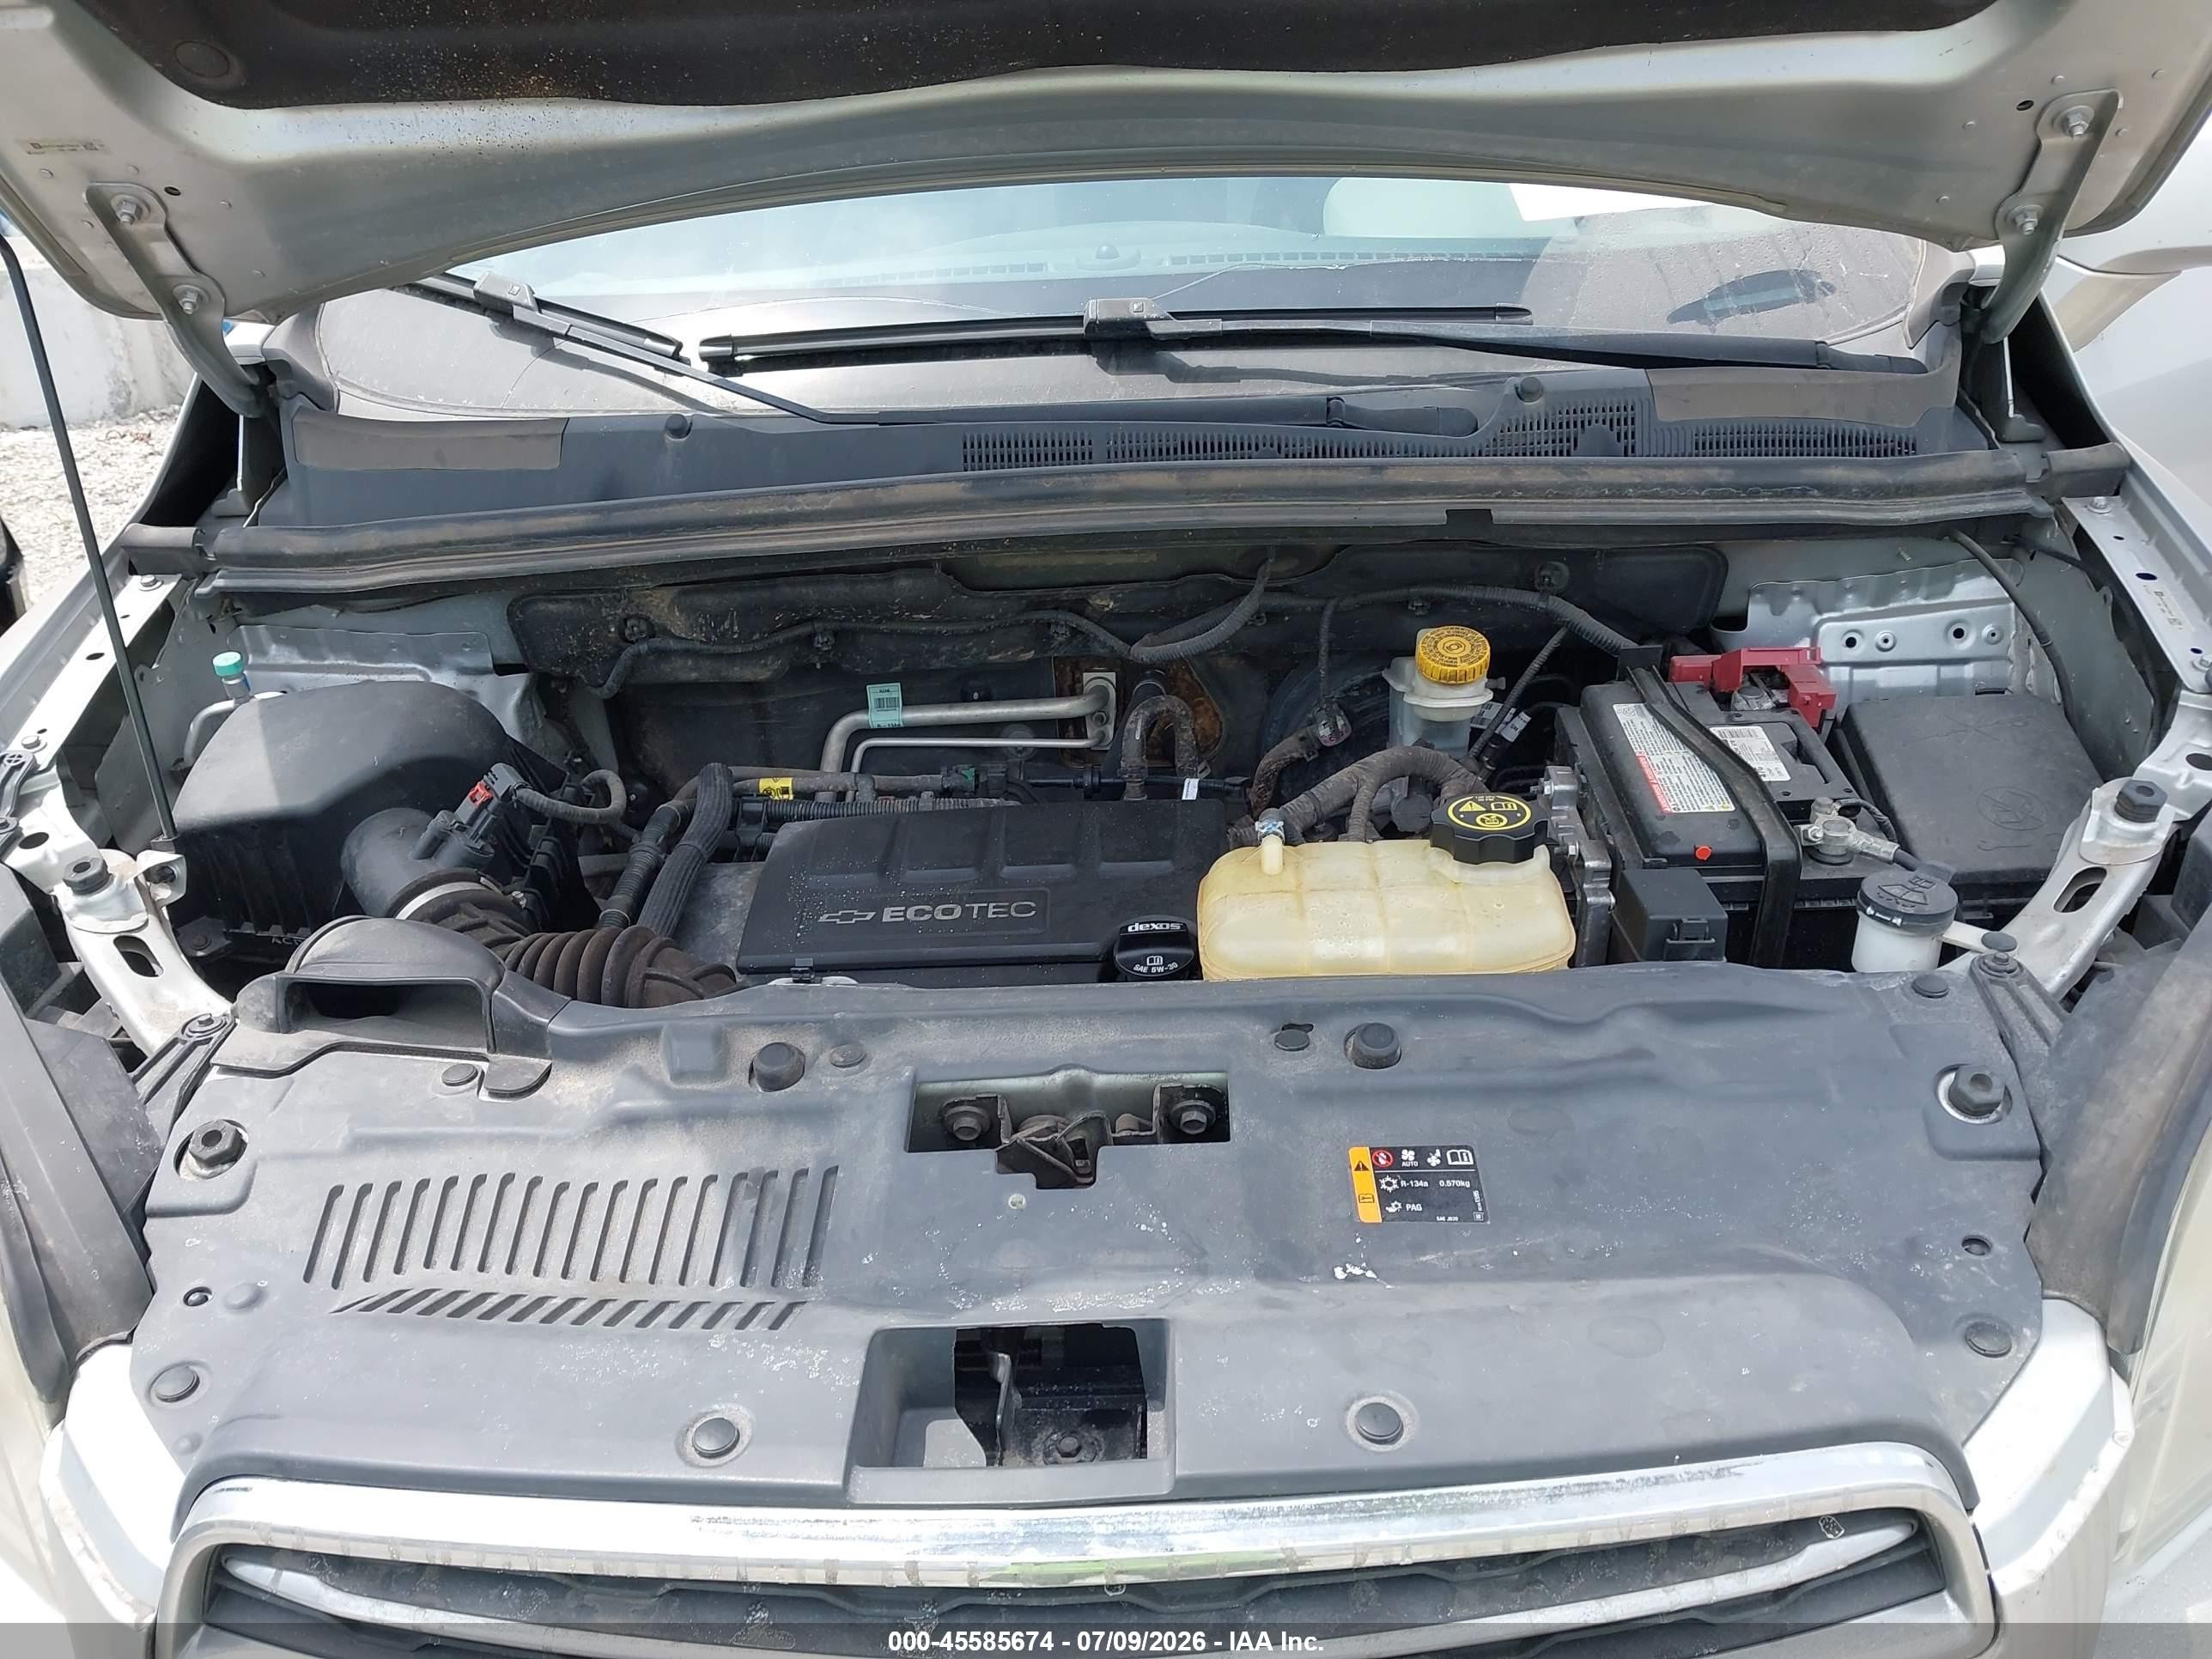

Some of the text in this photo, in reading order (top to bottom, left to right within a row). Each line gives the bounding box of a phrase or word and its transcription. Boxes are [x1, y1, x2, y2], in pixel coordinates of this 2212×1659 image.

[882, 902, 1037, 923] ECOTEC
[1127, 922, 1183, 933] dexos
[1133, 963, 1149, 973] SAE
[1438, 1180, 1471, 1188] 0.570kg
